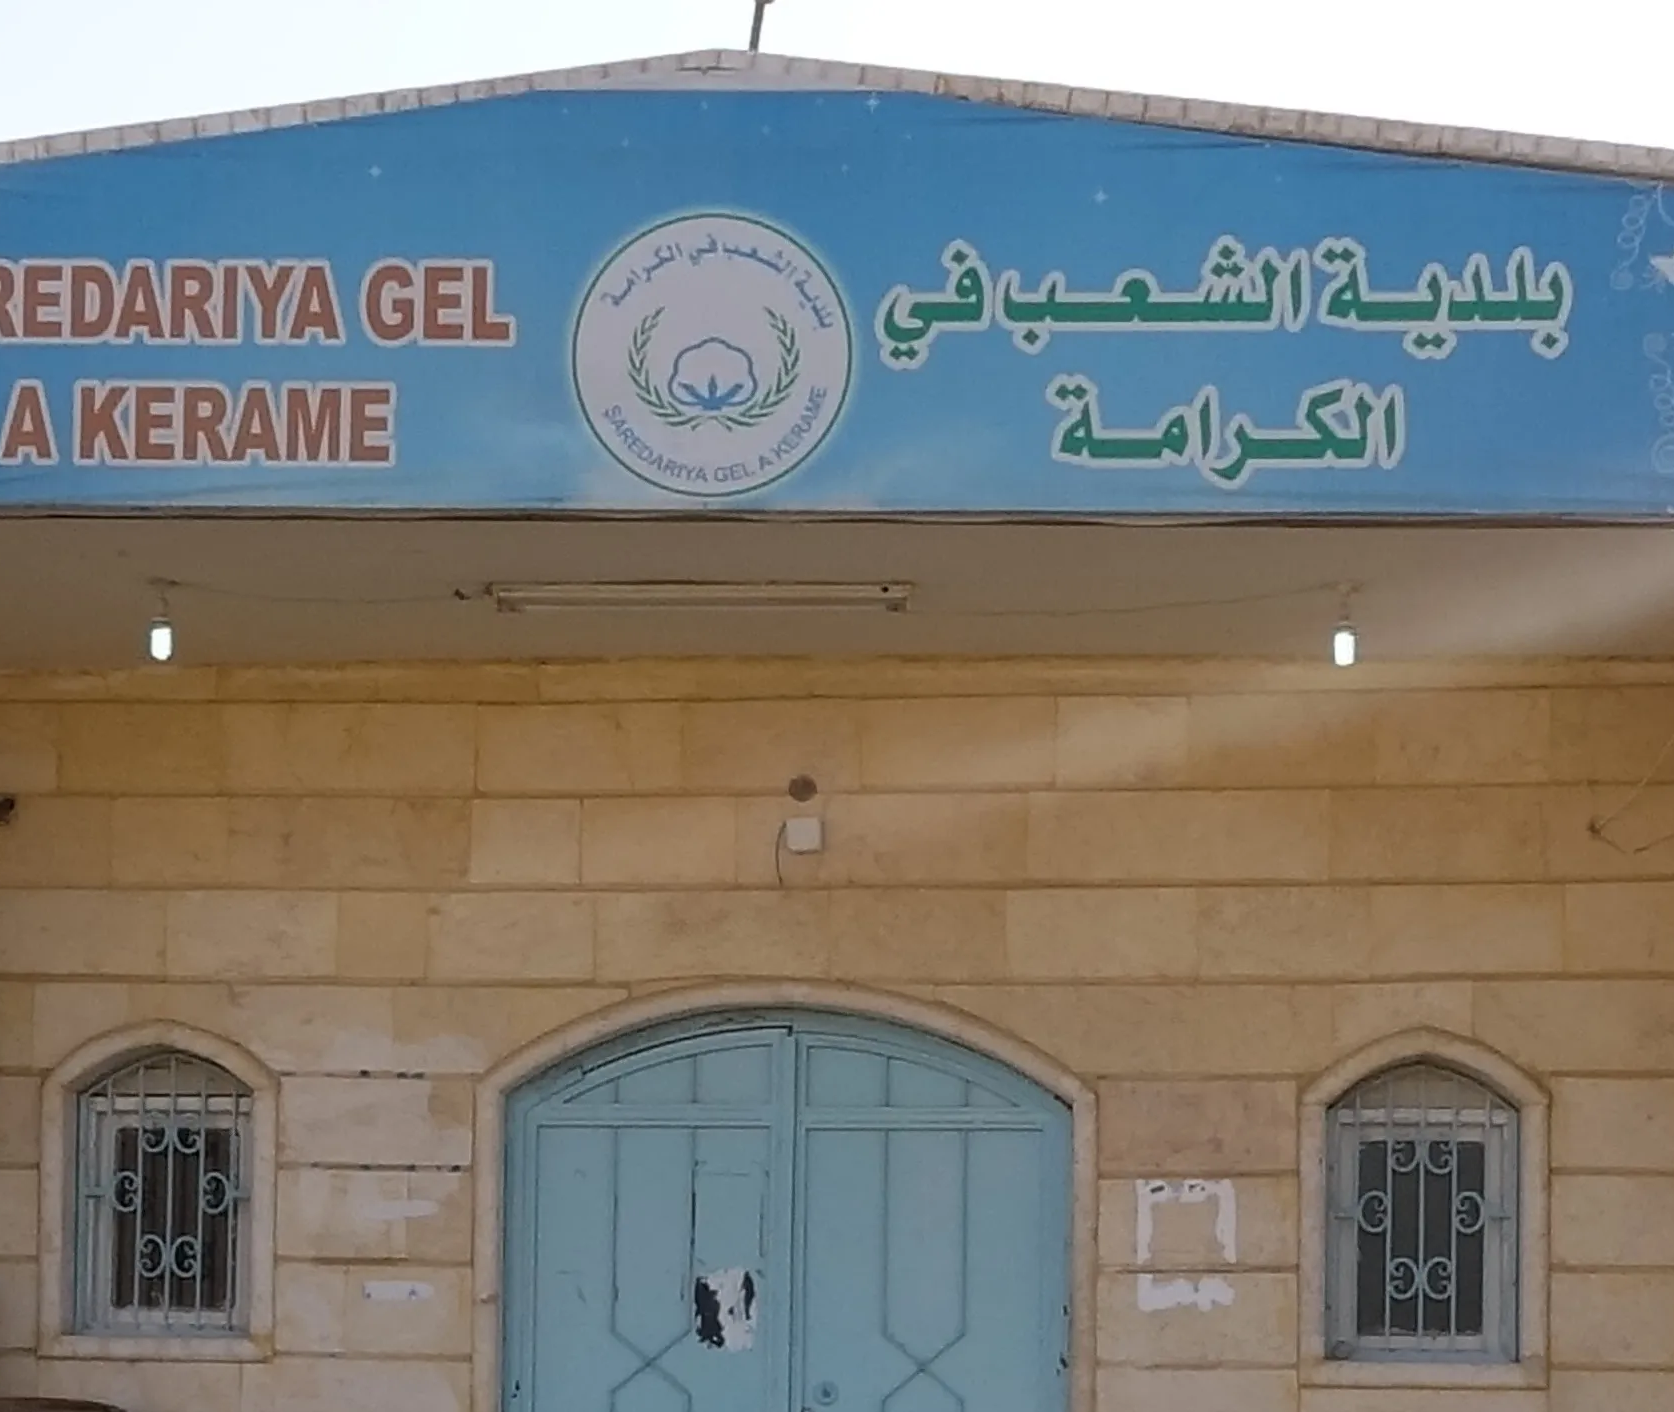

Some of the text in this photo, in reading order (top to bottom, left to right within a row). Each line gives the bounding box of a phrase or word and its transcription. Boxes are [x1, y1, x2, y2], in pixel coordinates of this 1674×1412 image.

[362, 263, 512, 342] GEL
[599, 232, 834, 331] بلدية الشعب في الكرامة
[881, 243, 1566, 363] بلدية الشعب في
[1, 385, 392, 463] A KERAME
[713, 462, 756, 483] GEL
[757, 454, 775, 471] A
[1052, 382, 1405, 482] الكرامة
